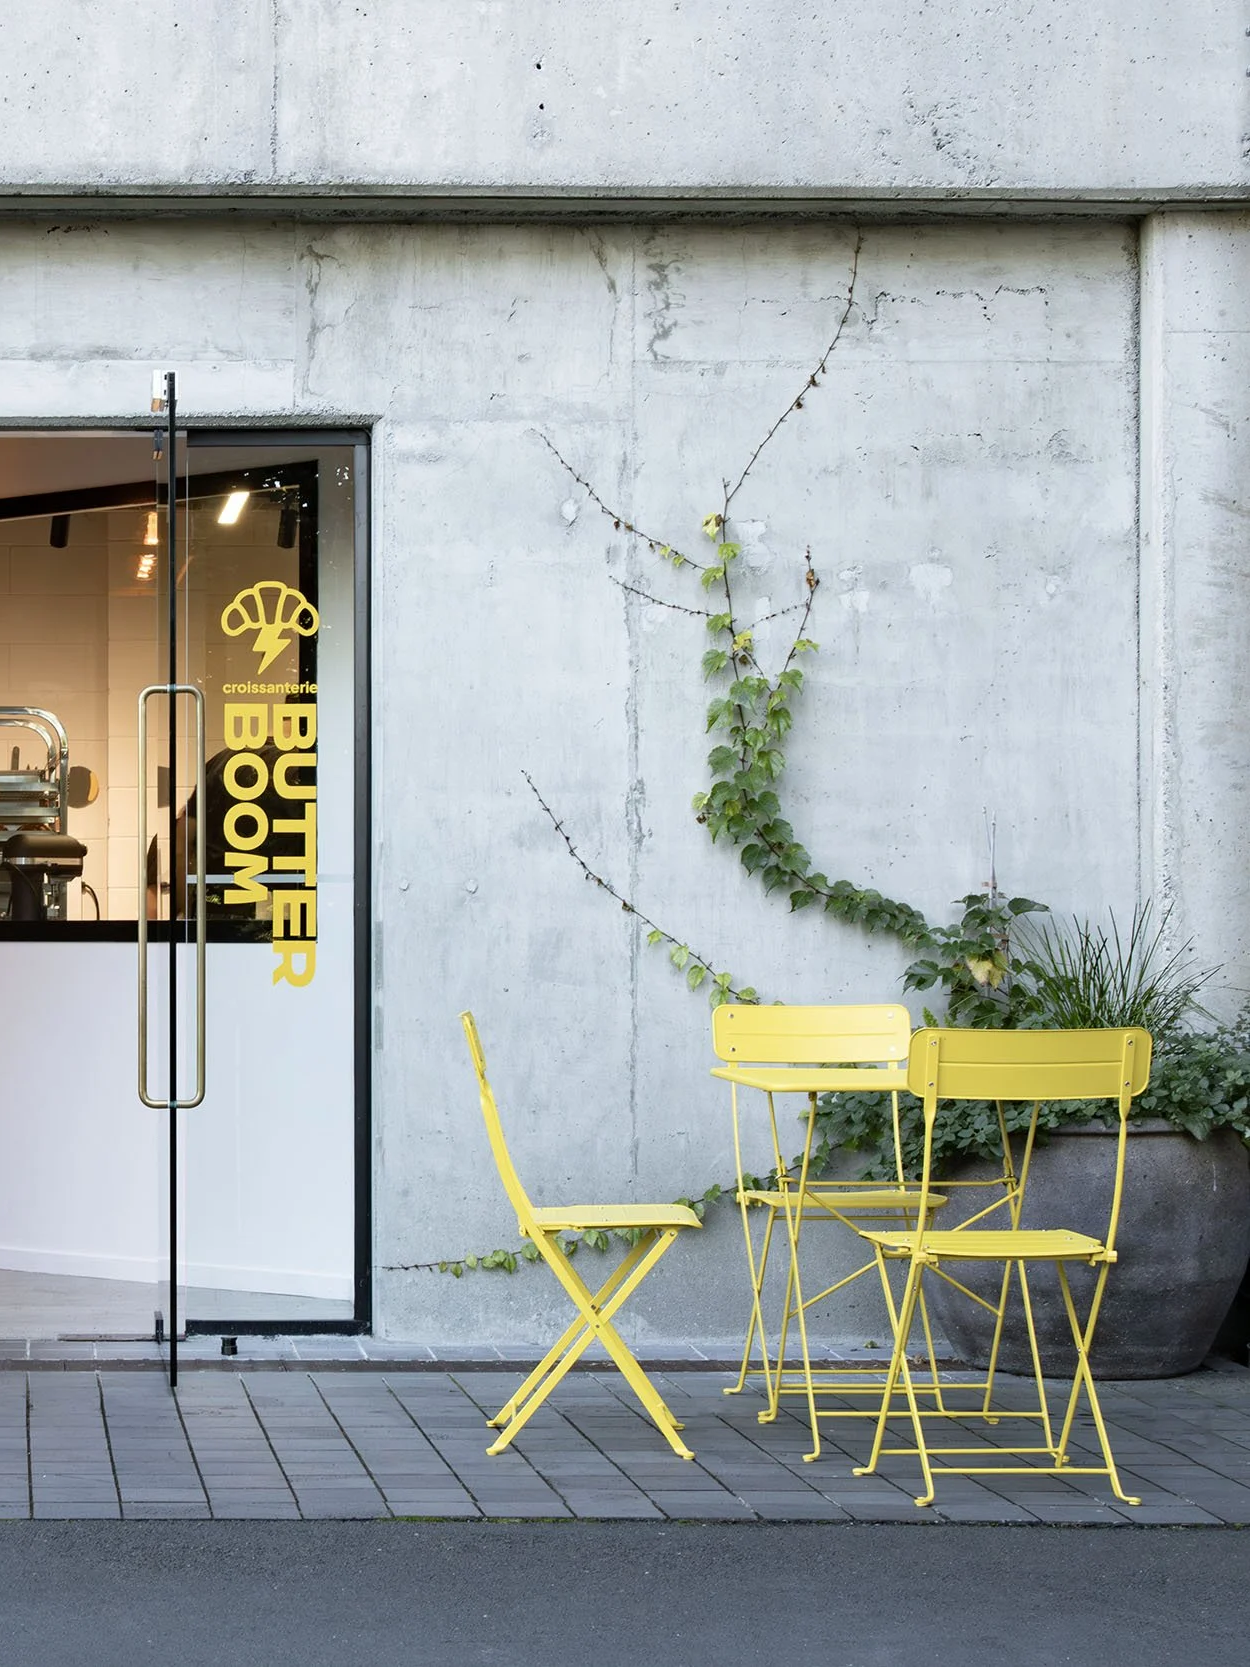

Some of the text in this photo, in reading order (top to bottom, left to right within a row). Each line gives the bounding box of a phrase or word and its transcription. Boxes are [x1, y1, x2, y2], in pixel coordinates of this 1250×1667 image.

[221, 680, 318, 695] croissanterie
[223, 703, 269, 905] BOOM
[272, 703, 317, 988] BUTTER
